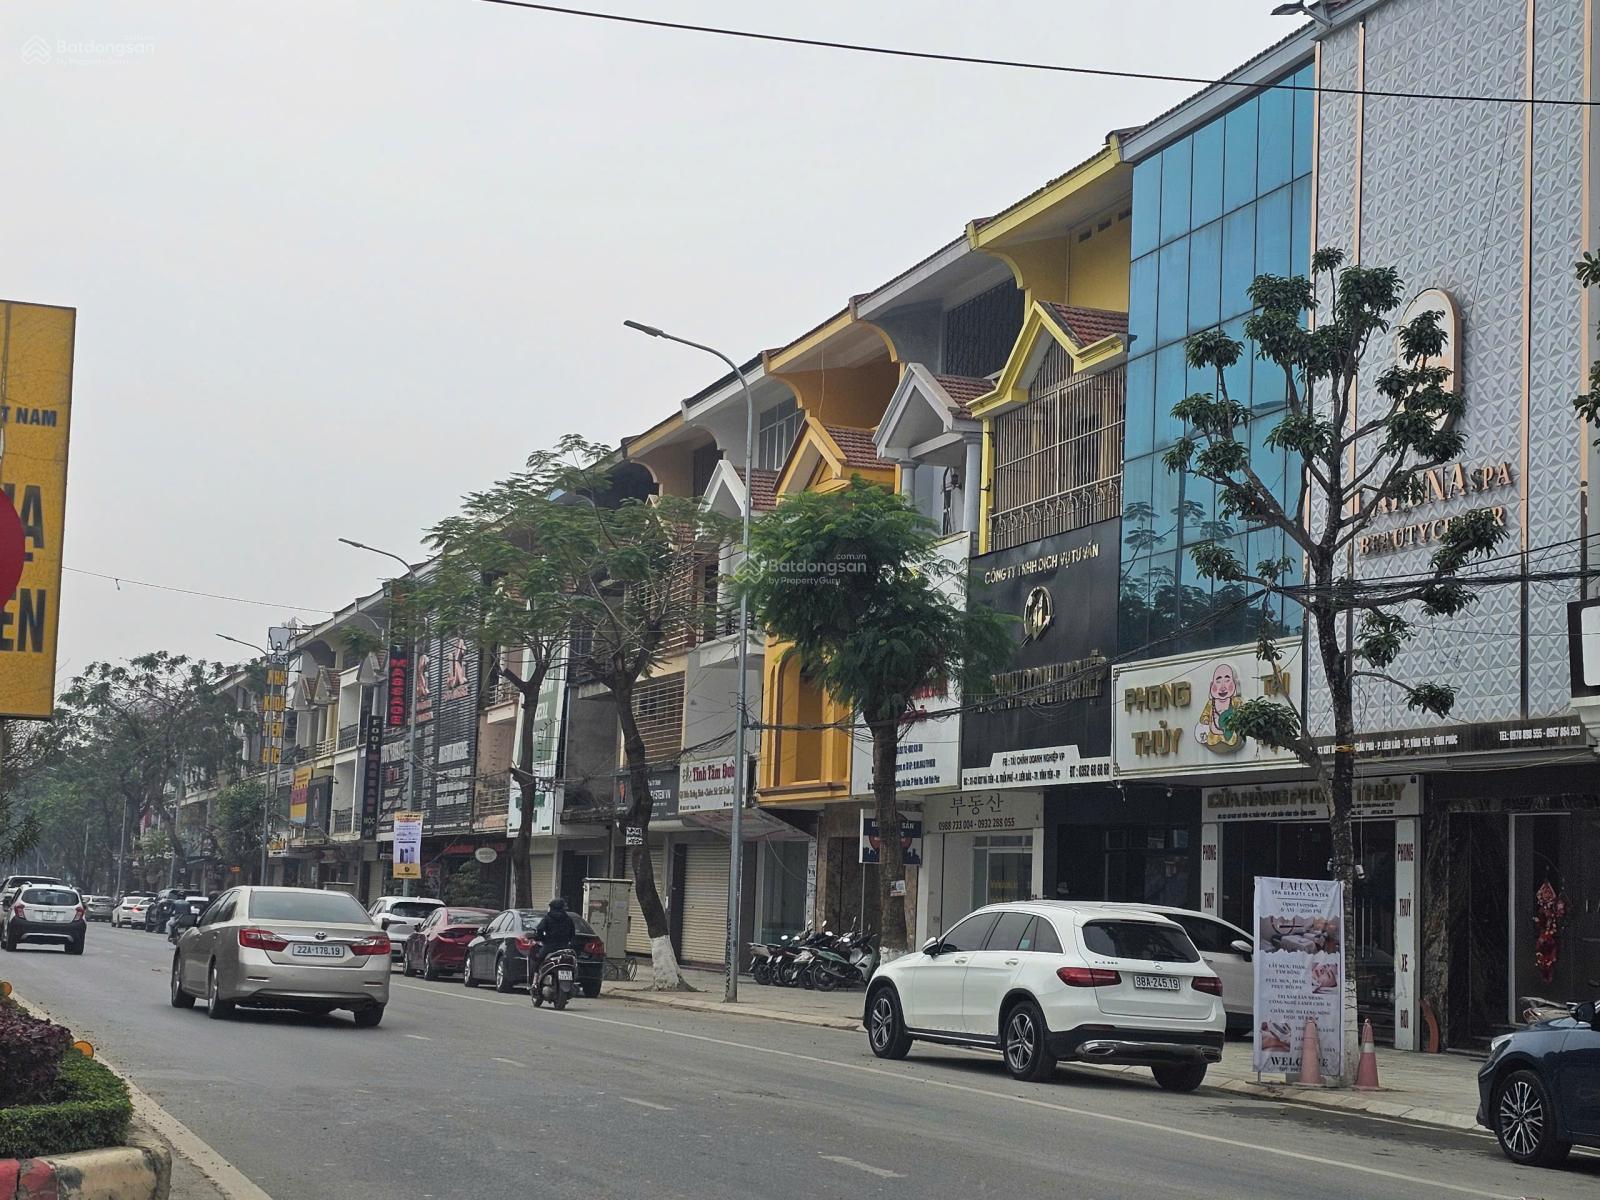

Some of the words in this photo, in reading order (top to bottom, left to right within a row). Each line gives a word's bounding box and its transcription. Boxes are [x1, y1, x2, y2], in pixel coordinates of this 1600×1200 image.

[16, 406, 58, 428] NAM
[1038, 554, 1058, 574] DỊCH
[1124, 681, 1191, 713] PHONG
[371, 719, 380, 751] FOOT
[1131, 719, 1183, 757] THỦY
[949, 792, 1005, 817] 부동산
[1397, 843, 1414, 862] PHONG
[296, 945, 341, 956] 22A-178.19
[1401, 953, 1408, 973] XE
[1270, 1056, 1329, 1068] WELCE
